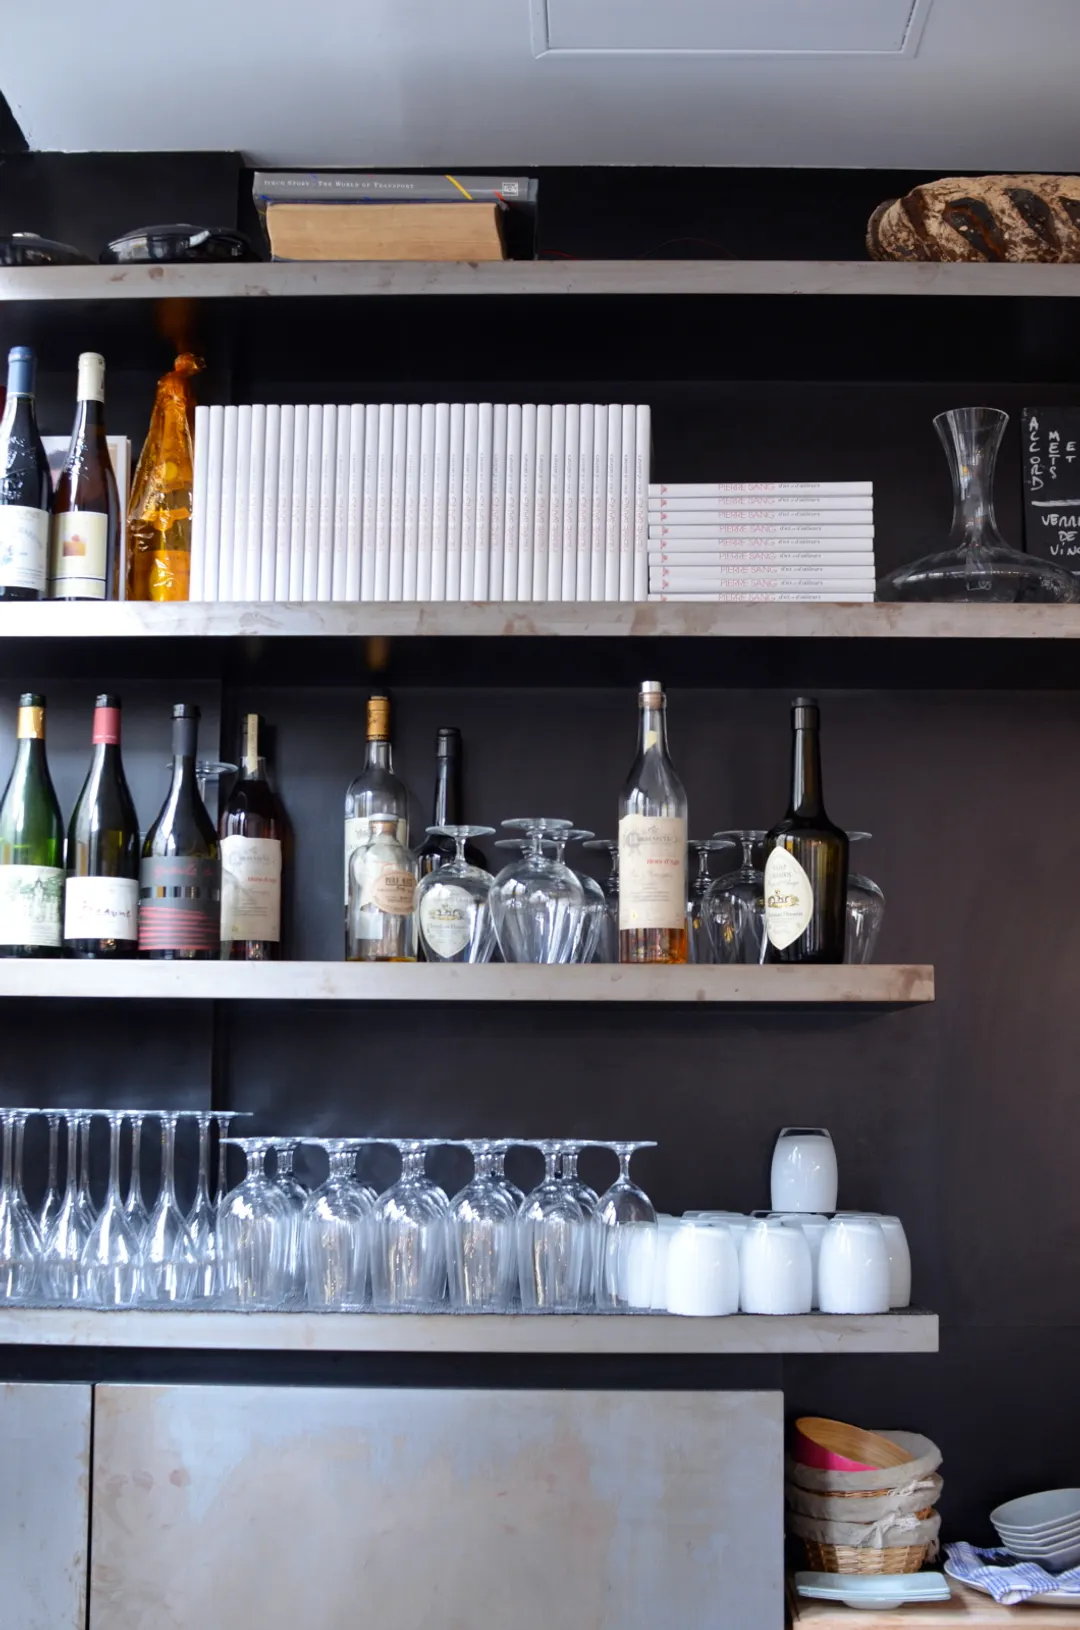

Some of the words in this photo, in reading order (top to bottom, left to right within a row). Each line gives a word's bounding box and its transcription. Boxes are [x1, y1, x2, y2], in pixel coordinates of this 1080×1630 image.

[335, 180, 360, 188] WORLD
[1028, 416, 1044, 492] ACCORD
[1048, 430, 1060, 480] METS
[1066, 441, 1076, 464] ET
[719, 525, 746, 533] PIERRE
[750, 525, 776, 533] SANG
[1058, 530, 1078, 542] DE
[720, 579, 748, 587] PIERRE
[751, 579, 778, 587] SANG
